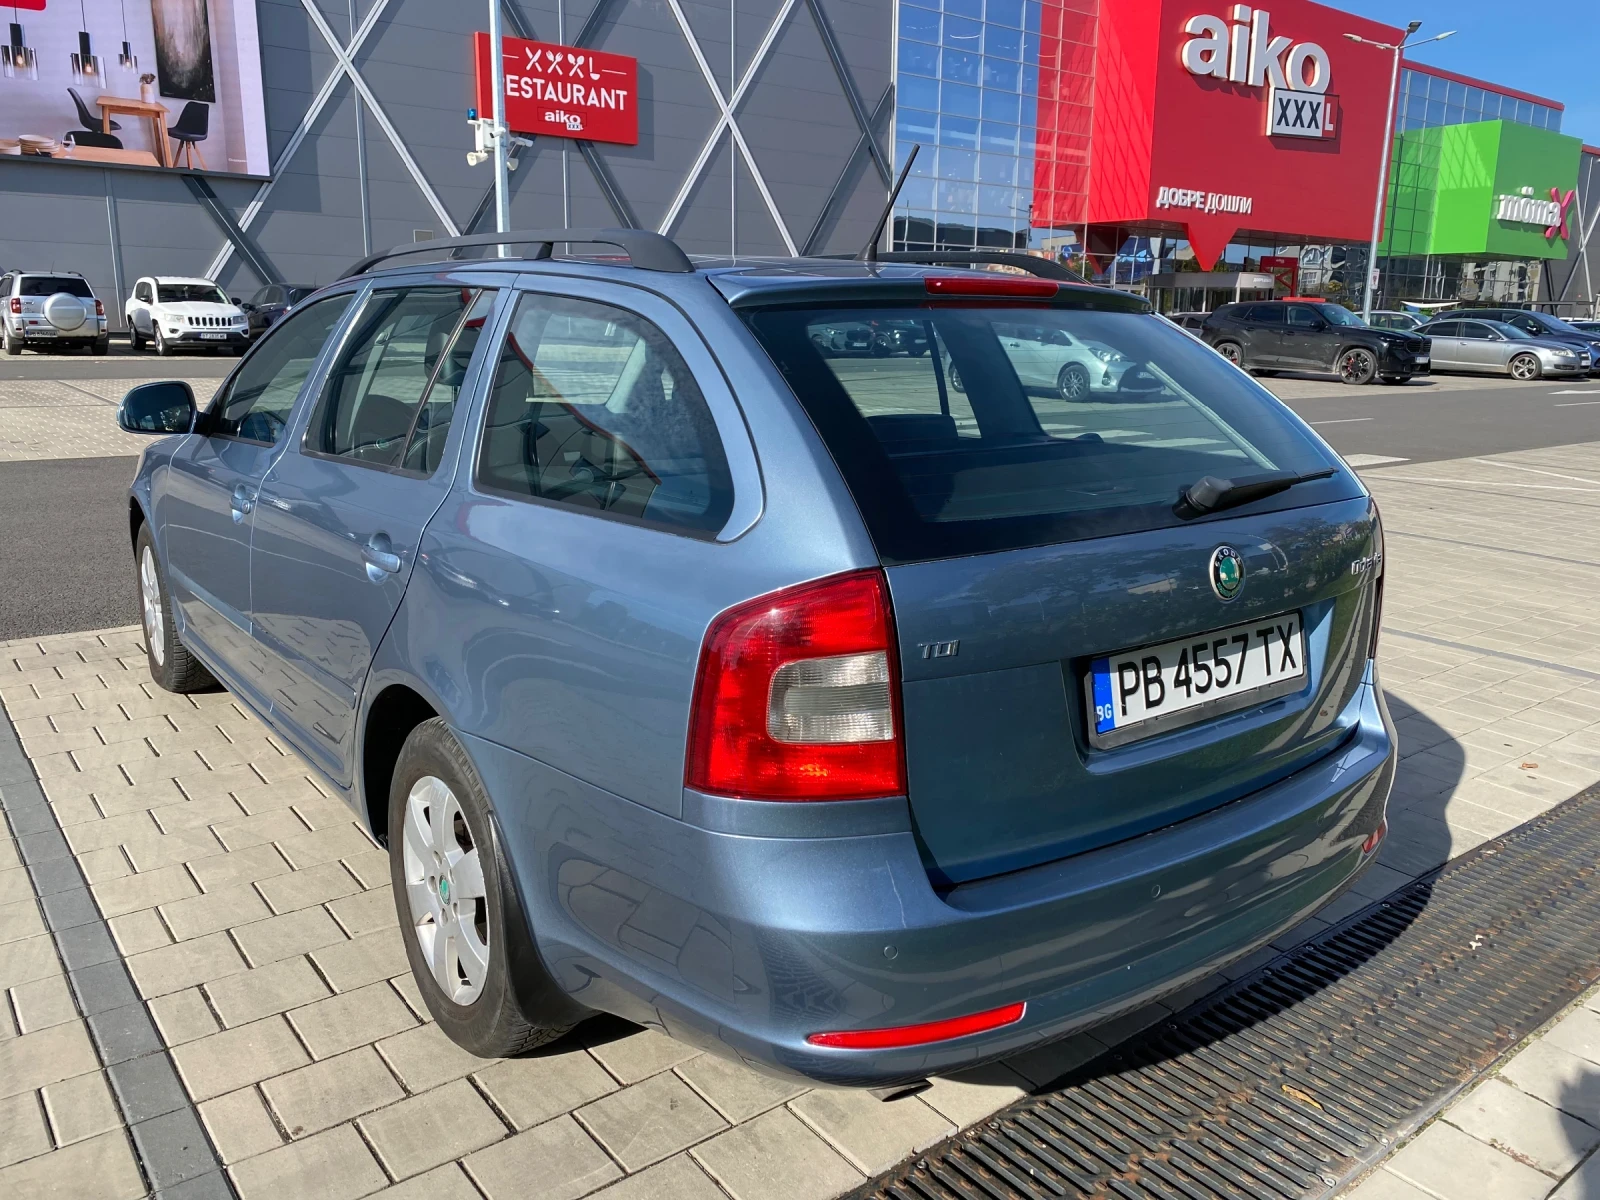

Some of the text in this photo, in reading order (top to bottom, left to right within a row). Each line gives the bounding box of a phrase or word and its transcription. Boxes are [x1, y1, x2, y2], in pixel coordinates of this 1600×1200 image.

[1182, 4, 1331, 94] aiko
[502, 74, 628, 110] ESTAURANT
[544, 110, 581, 123] aiko
[1276, 97, 1334, 131] XXXL
[1156, 186, 1252, 214] ДОБРЕ ДОШЛИ
[917, 639, 959, 659] TDI
[1117, 622, 1298, 717] PB 4557 TX
